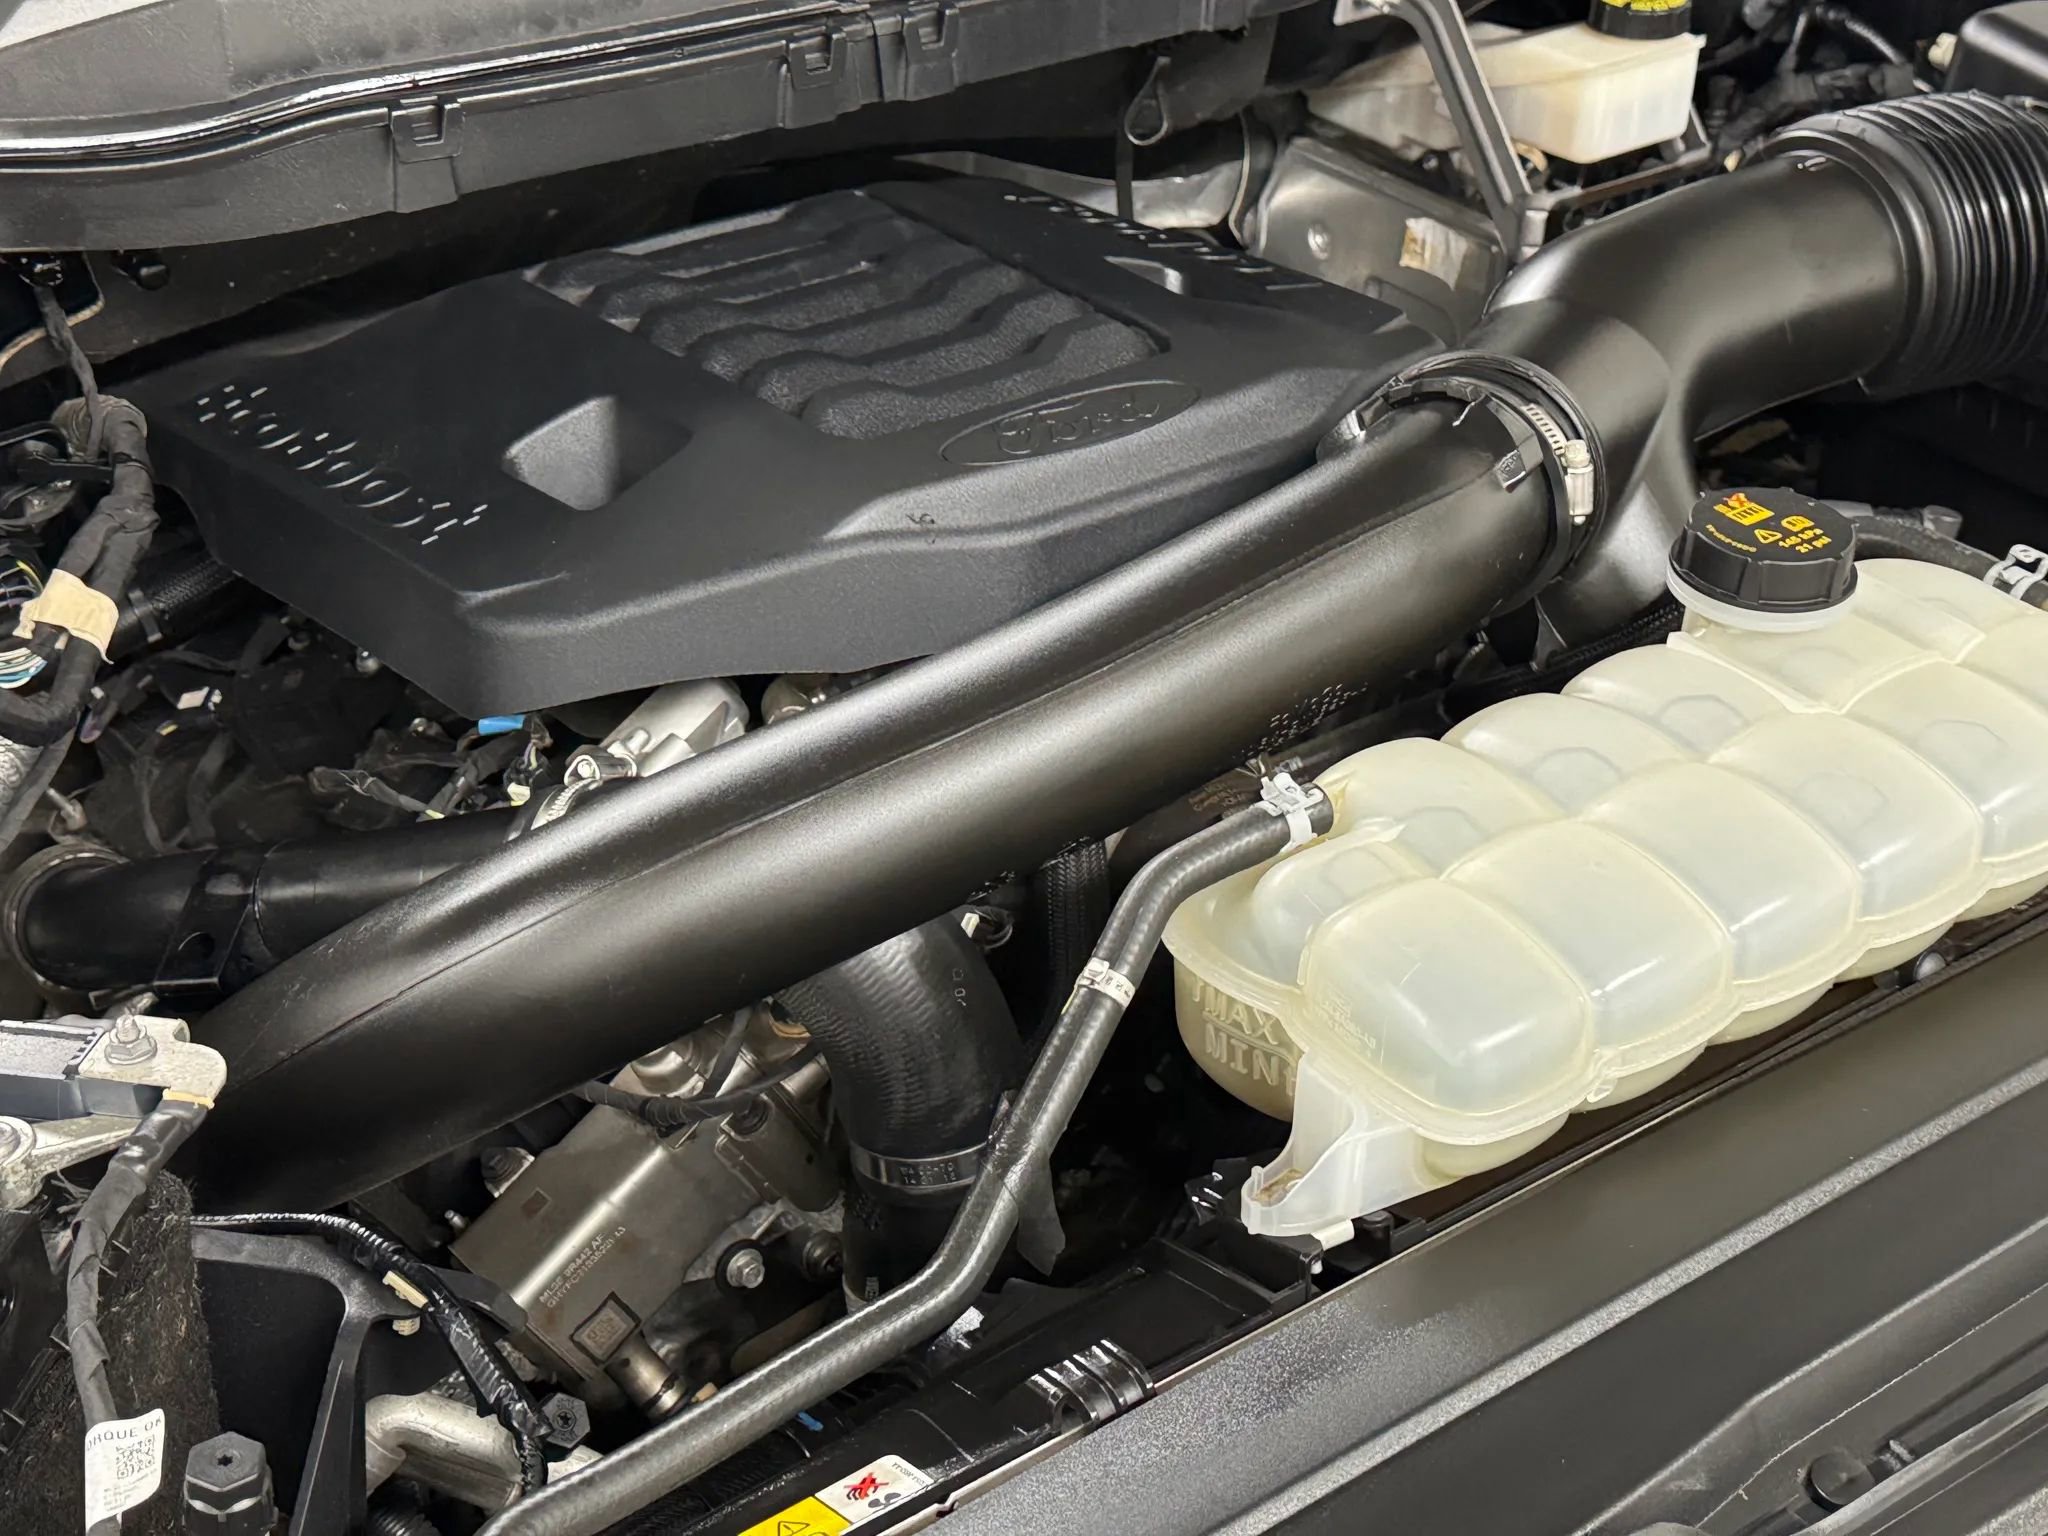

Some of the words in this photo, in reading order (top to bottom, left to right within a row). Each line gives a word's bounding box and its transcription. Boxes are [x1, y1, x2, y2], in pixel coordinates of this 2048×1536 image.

[994, 398, 1161, 455] Ford
[1204, 985, 1280, 1046] MAX
[1204, 1022, 1280, 1087] MIN
